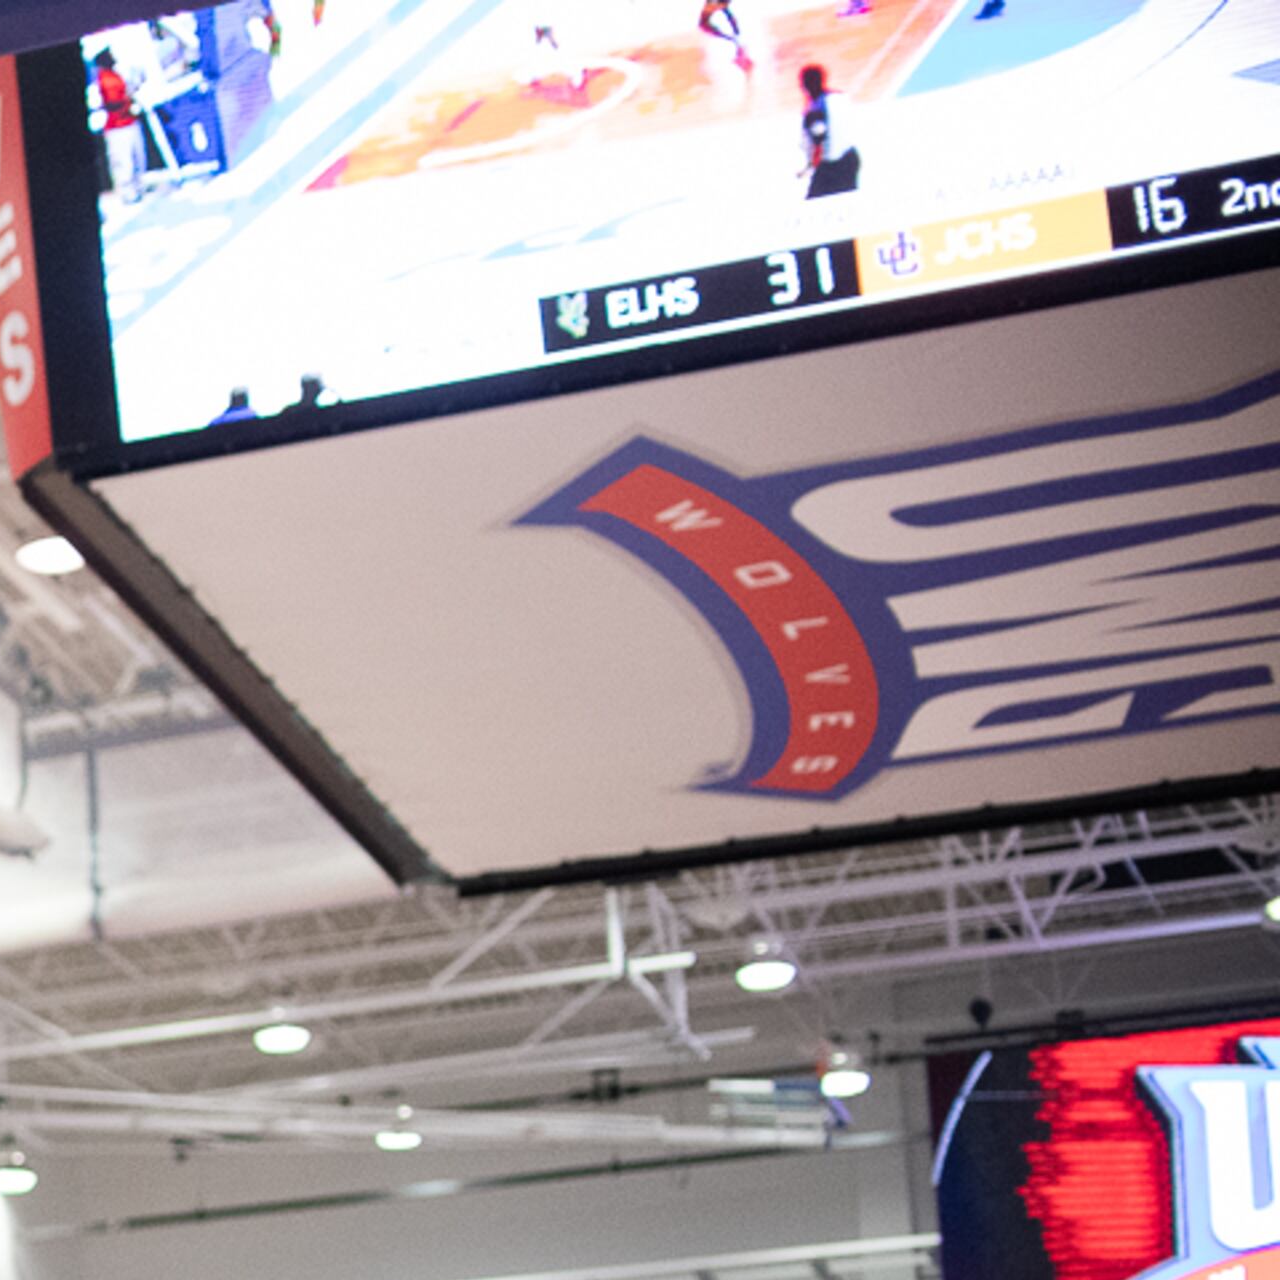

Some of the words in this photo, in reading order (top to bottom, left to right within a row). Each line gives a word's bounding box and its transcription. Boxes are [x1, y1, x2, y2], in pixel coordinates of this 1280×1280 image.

[605, 275, 699, 329] ELHS
[765, 247, 834, 306] 31
[934, 211, 1037, 266] JCHS
[1132, 176, 1187, 234] 16
[655, 498, 855, 774] WOLVES
